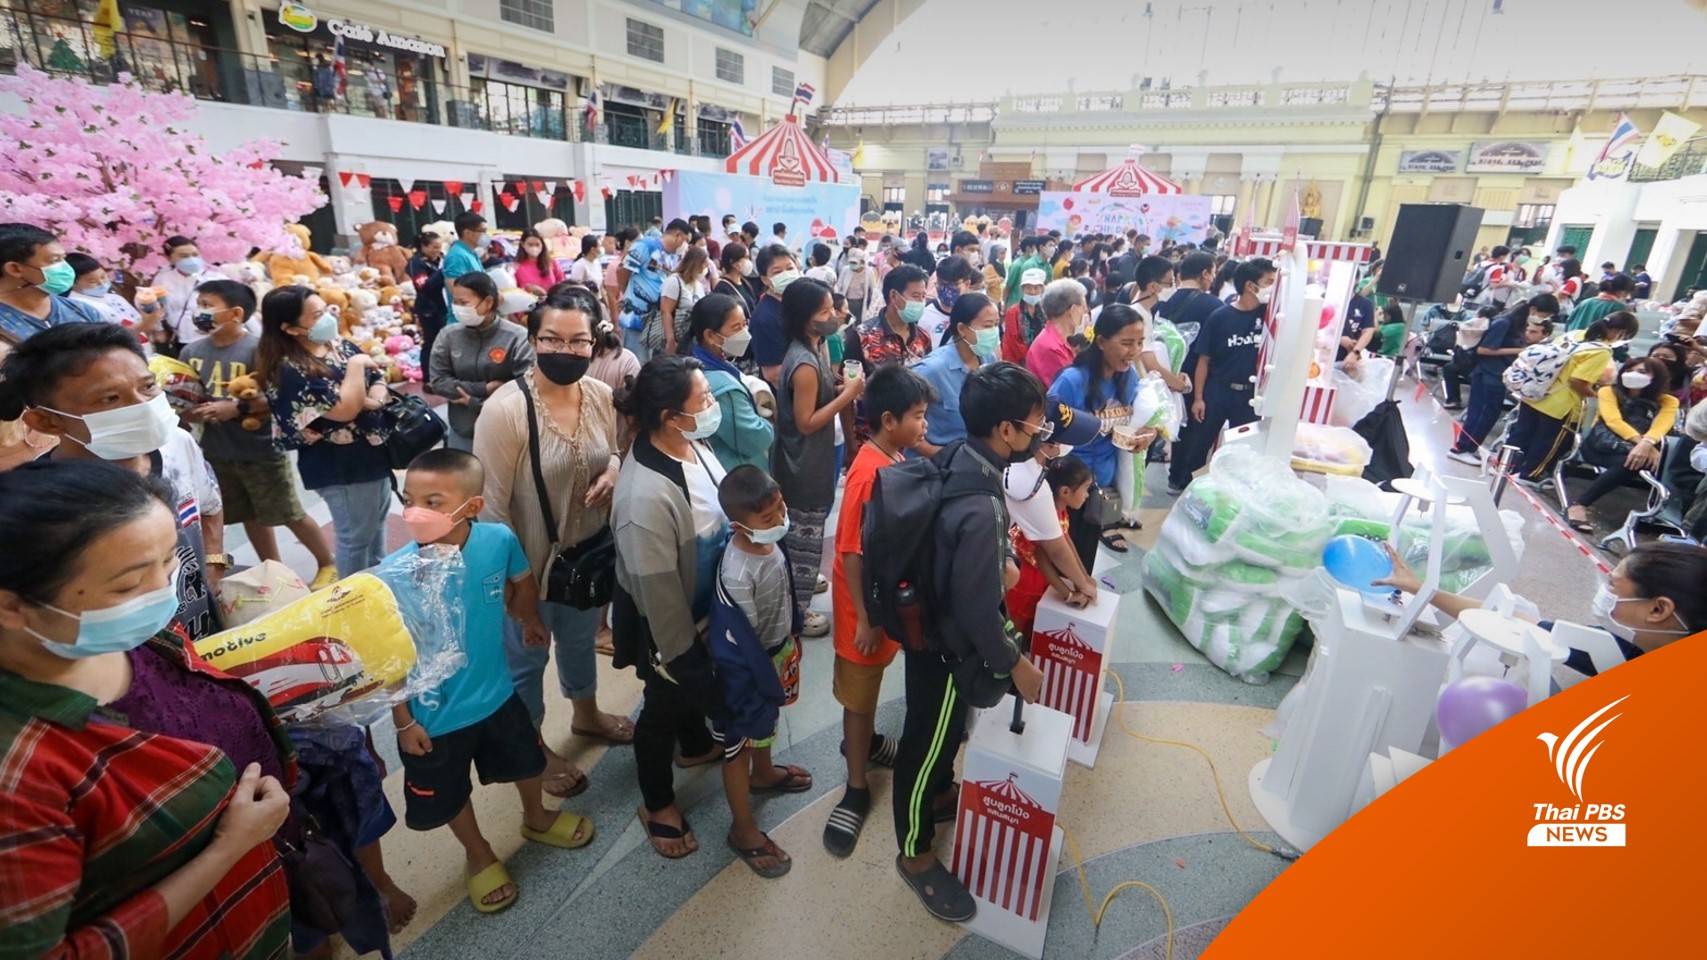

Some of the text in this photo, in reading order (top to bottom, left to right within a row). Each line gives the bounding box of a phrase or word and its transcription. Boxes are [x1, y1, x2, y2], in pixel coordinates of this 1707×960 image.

[327, 19, 446, 58] Café Amazon
[983, 795, 1030, 820] สูบลูกโป่ง
